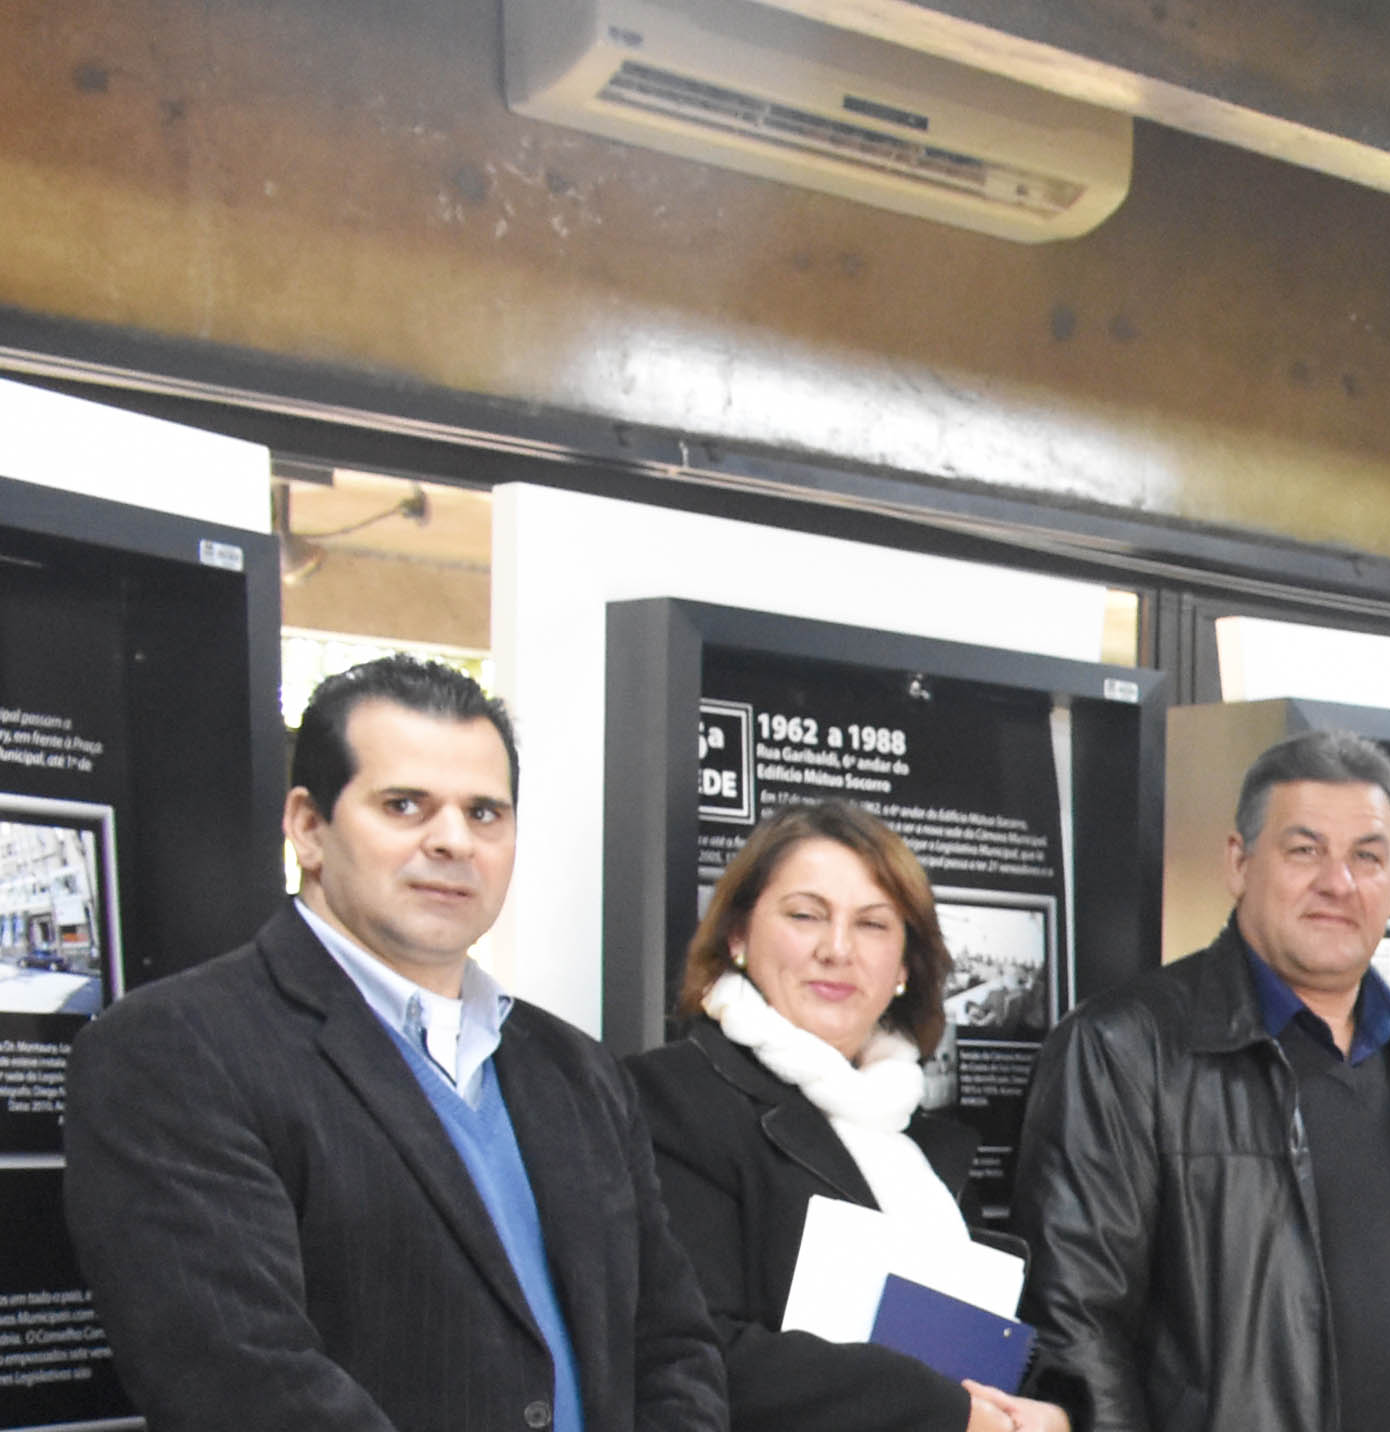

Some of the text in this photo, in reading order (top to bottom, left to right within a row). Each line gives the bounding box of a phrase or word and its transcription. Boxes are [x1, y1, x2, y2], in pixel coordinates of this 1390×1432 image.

[757, 712, 907, 756] 1962 a 1988
[756, 743, 781, 761] Rua
[782, 746, 841, 769] Garibaldi,
[857, 755, 891, 774] andar
[892, 759, 911, 776] do
[845, 772, 892, 793] Socorro
